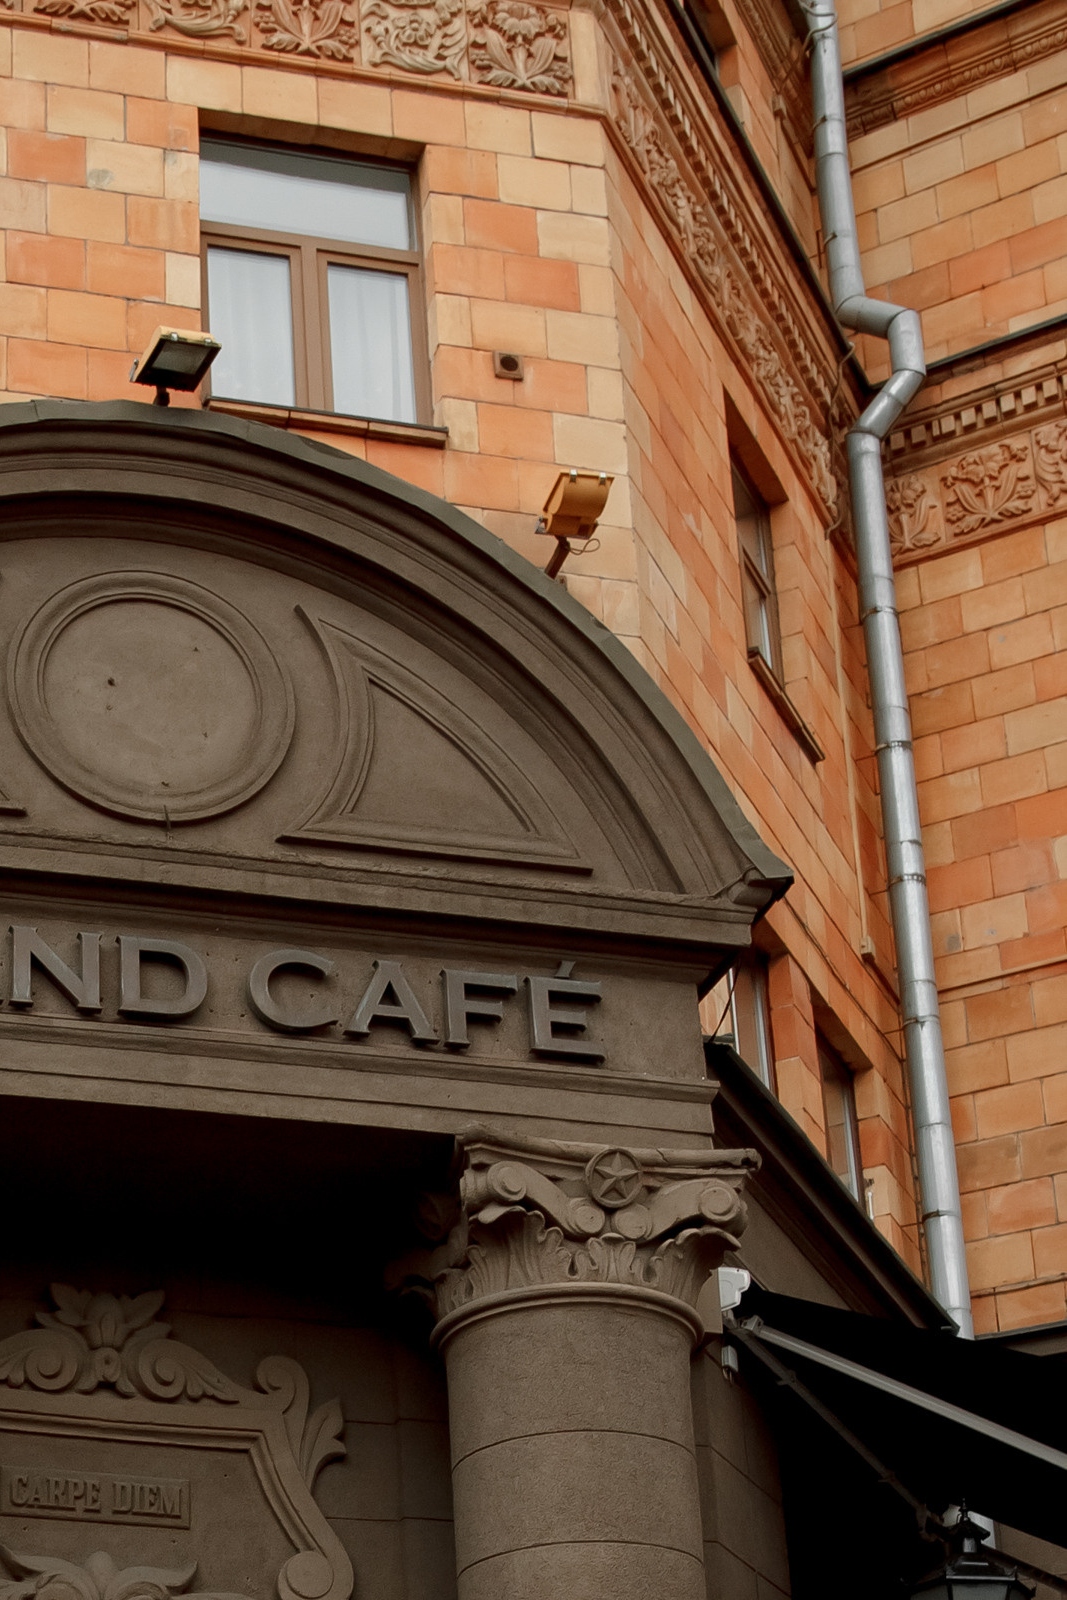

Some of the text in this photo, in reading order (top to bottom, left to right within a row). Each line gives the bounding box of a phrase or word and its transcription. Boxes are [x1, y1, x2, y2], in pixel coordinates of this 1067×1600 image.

[248, 949, 606, 1065] CAFÉ
[9, 1474, 182, 1519] CARPE DIEM
